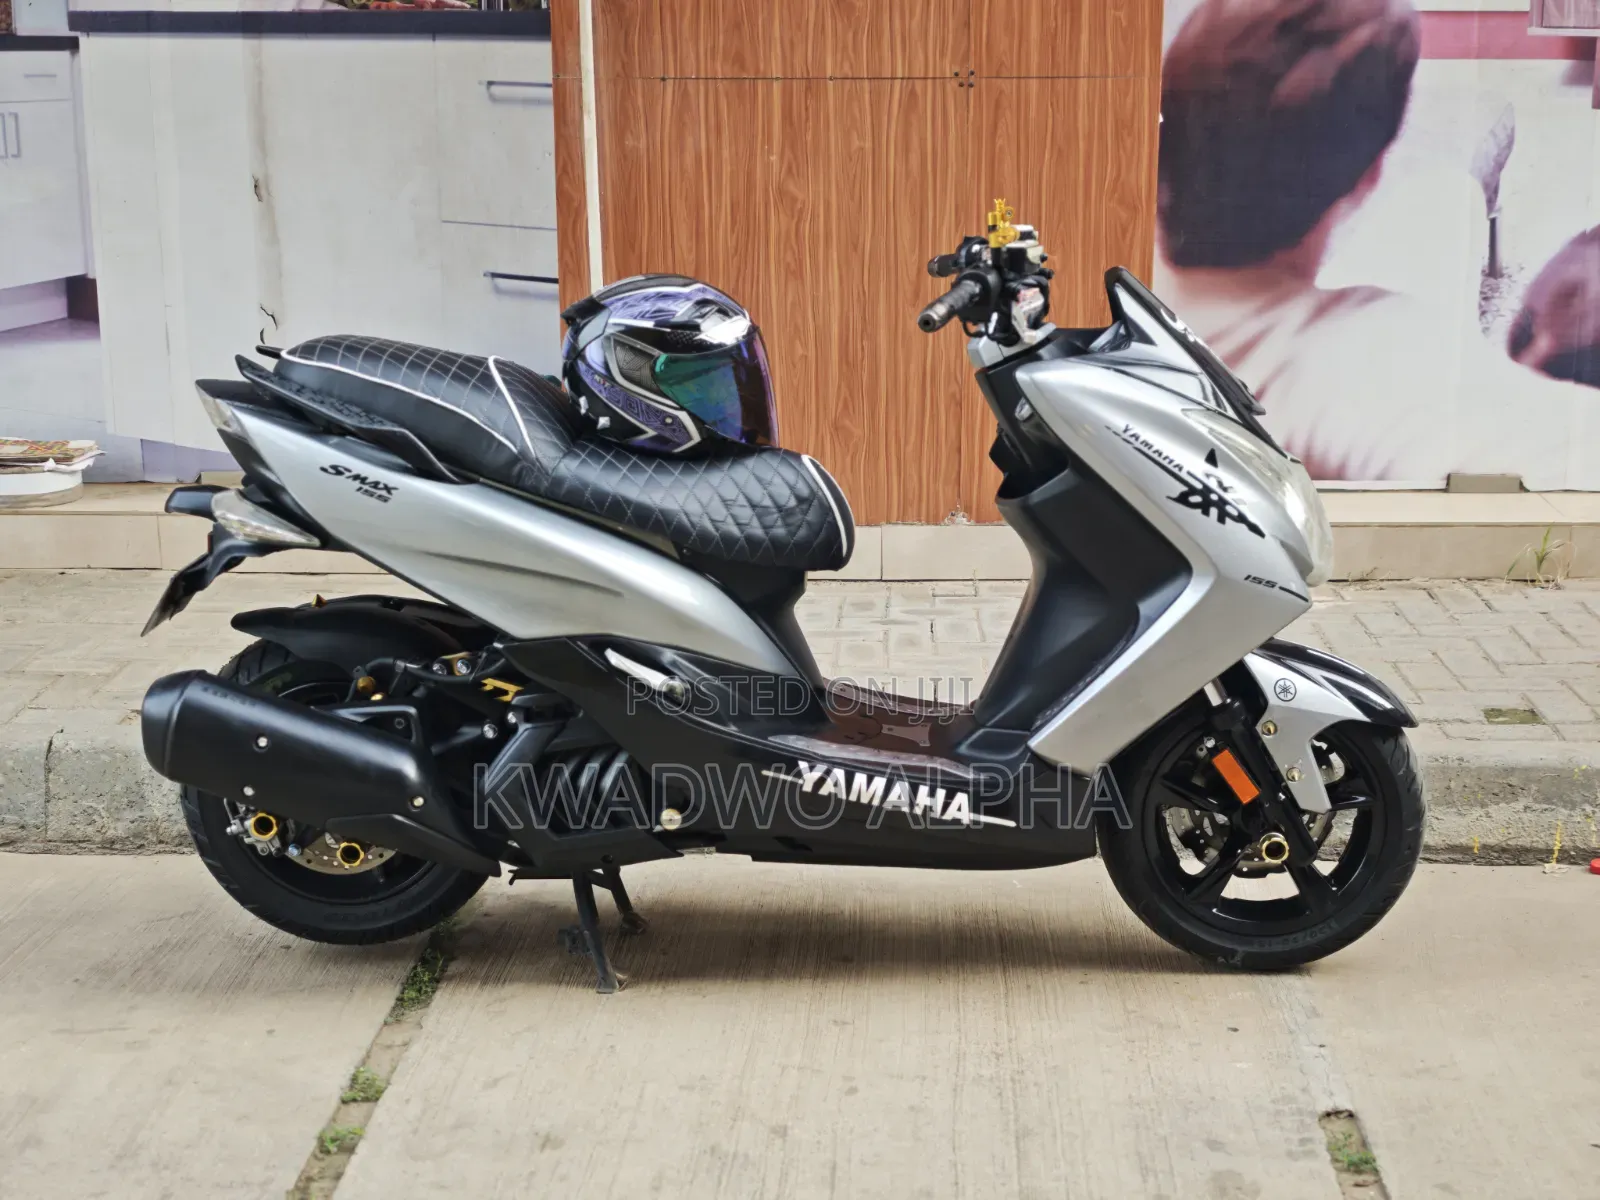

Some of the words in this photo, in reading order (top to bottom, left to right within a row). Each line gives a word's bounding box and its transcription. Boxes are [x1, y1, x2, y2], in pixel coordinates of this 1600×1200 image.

[1121, 424, 1184, 473] YAMAHA
[355, 486, 392, 503] 155
[1243, 574, 1278, 589] 155
[797, 760, 970, 825] YAMAHA
